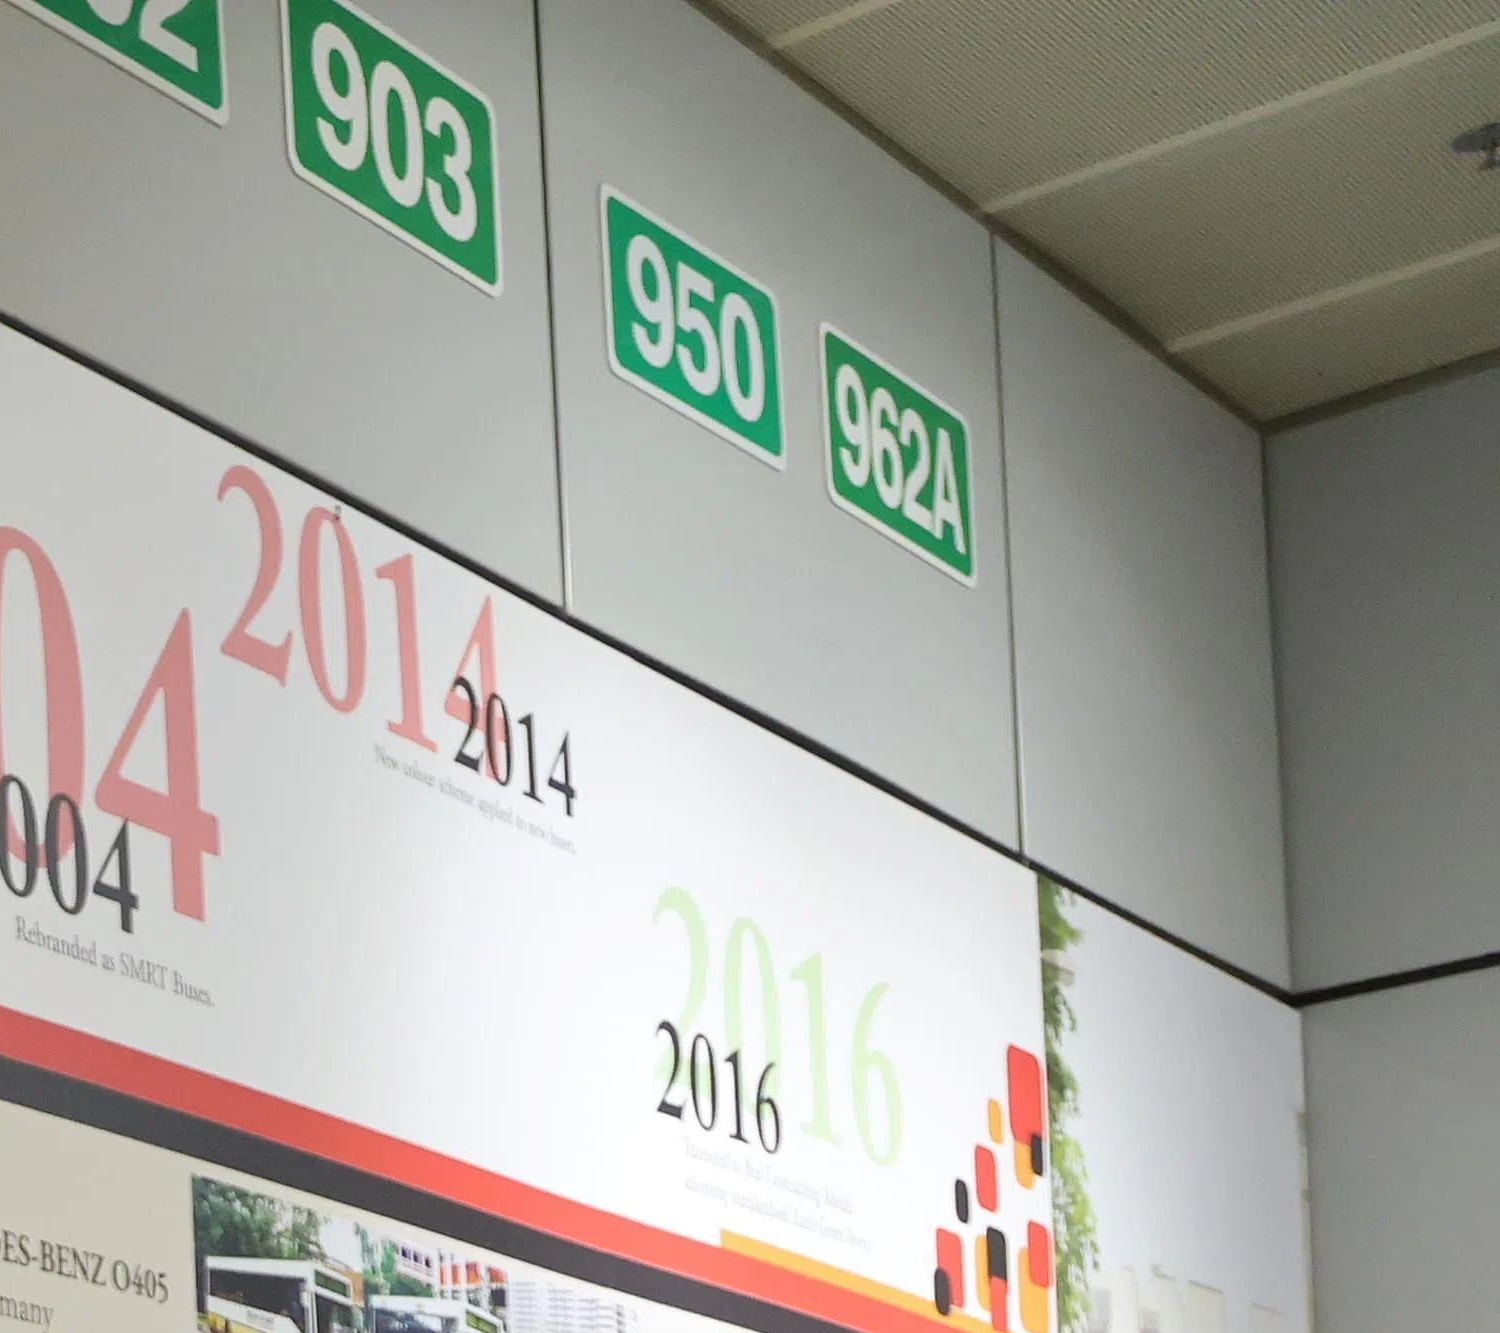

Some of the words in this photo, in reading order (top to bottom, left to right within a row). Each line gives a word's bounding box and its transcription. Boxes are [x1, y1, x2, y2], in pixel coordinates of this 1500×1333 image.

[310, 21, 479, 244] 903
[625, 233, 766, 424] 950
[834, 362, 967, 557] 962A
[217, 463, 510, 781] 2014
[451, 676, 579, 819] 2014
[15, 915, 98, 967] Rebranded
[100, 952, 116, 973] as
[119, 951, 168, 991] SMRT
[172, 969, 216, 1008] Buses.
[652, 885, 903, 1168] 2016
[655, 1019, 783, 1155] 2016
